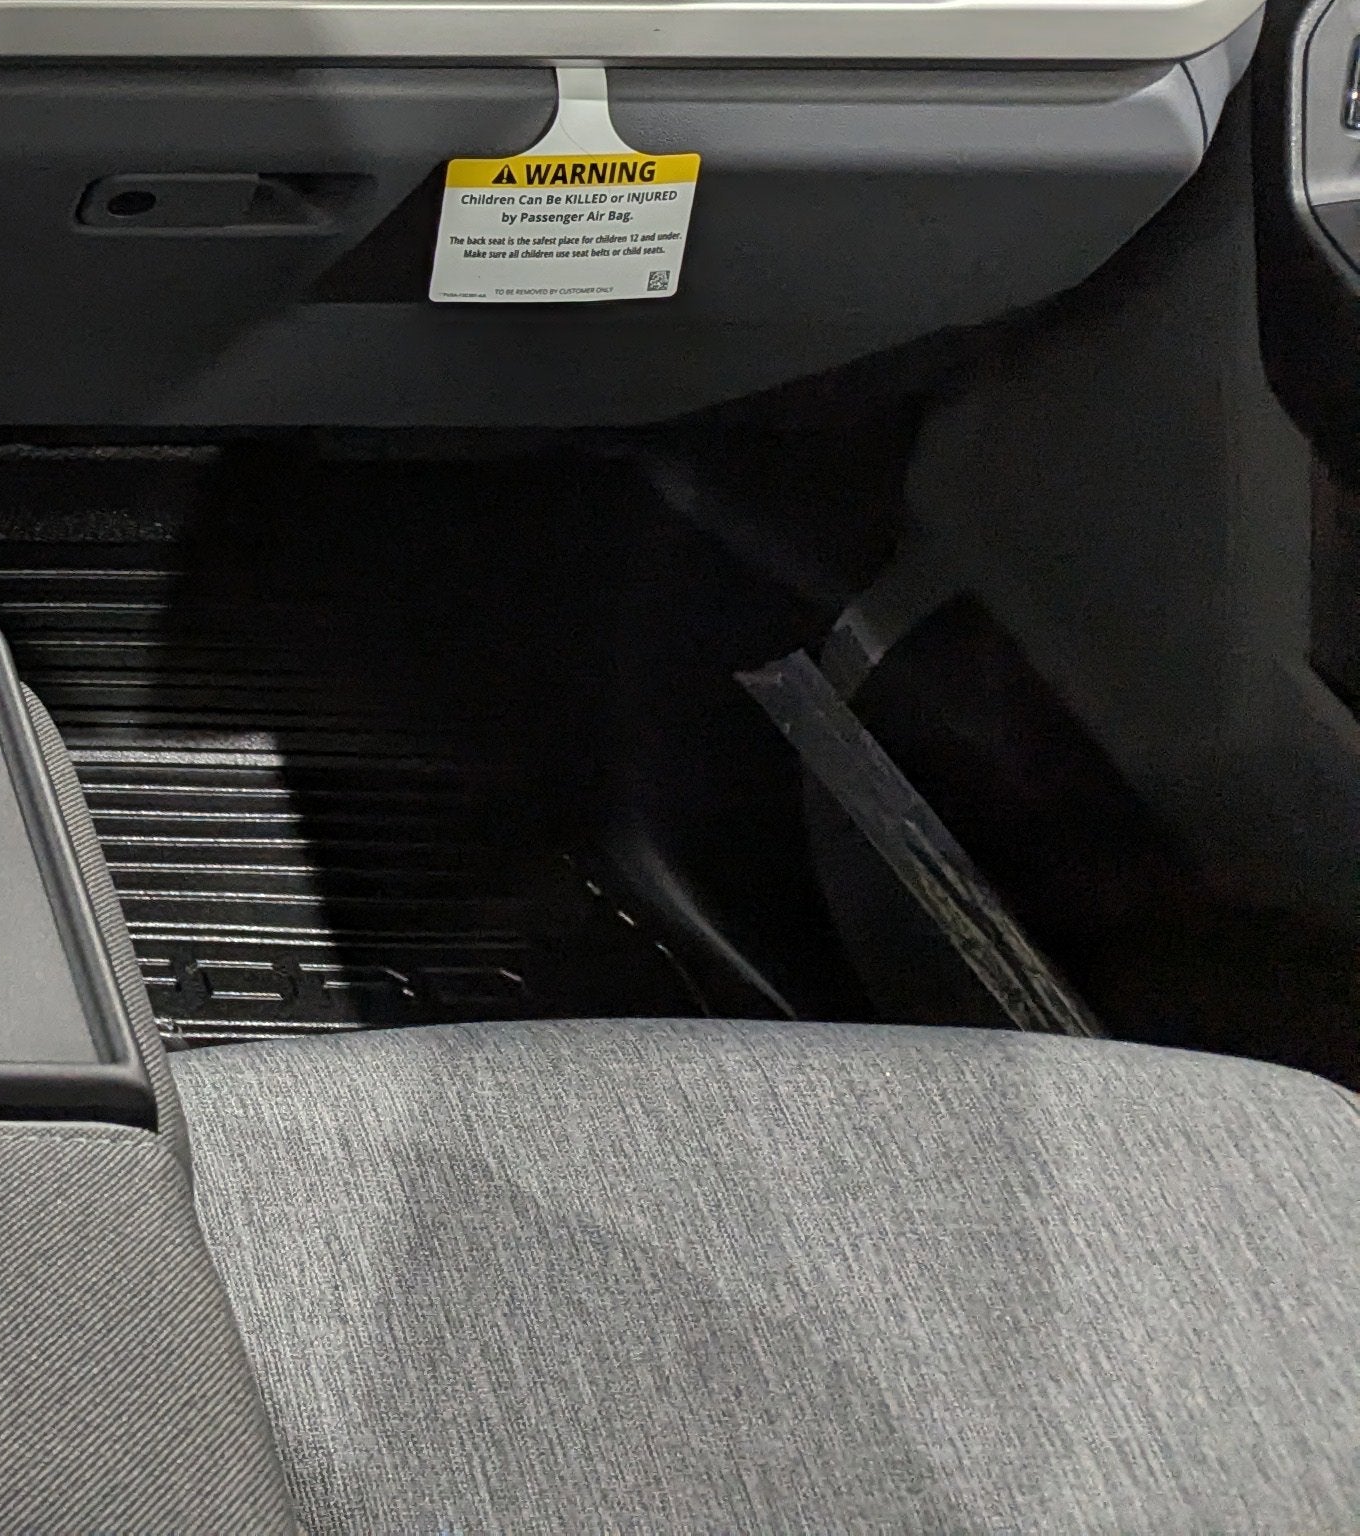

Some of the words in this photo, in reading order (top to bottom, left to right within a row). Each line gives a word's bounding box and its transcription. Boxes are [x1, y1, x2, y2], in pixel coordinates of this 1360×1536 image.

[524, 161, 657, 186] WARNING
[461, 194, 515, 205] Children
[518, 194, 543, 205] Can
[545, 194, 562, 205] Be
[565, 193, 608, 205] KILLED
[610, 194, 625, 204] or
[626, 190, 678, 204] INJURED
[501, 212, 517, 225] by
[520, 212, 584, 226] Passenger
[587, 211, 605, 222] Air
[608, 210, 634, 223] Bag.
[449, 236, 464, 245] The
[467, 236, 486, 245] back
[488, 237, 506, 245] seat
[508, 236, 515, 245] is
[517, 236, 530, 245] the
[531, 236, 556, 245] safest
[558, 236, 579, 246] place
[581, 235, 594, 245] for
[595, 234, 627, 244] children
[630, 233, 639, 243] 12
[640, 233, 656, 242] and
[657, 232, 682, 241] under.
[463, 249, 486, 258] Make
[489, 250, 507, 258] sure
[508, 249, 519, 258] all
[521, 249, 554, 258] children
[556, 250, 569, 258] use
[572, 249, 589, 257] seat
[591, 248, 610, 257] belts
[622, 246, 641, 255] child
[643, 246, 665, 255] seats.
